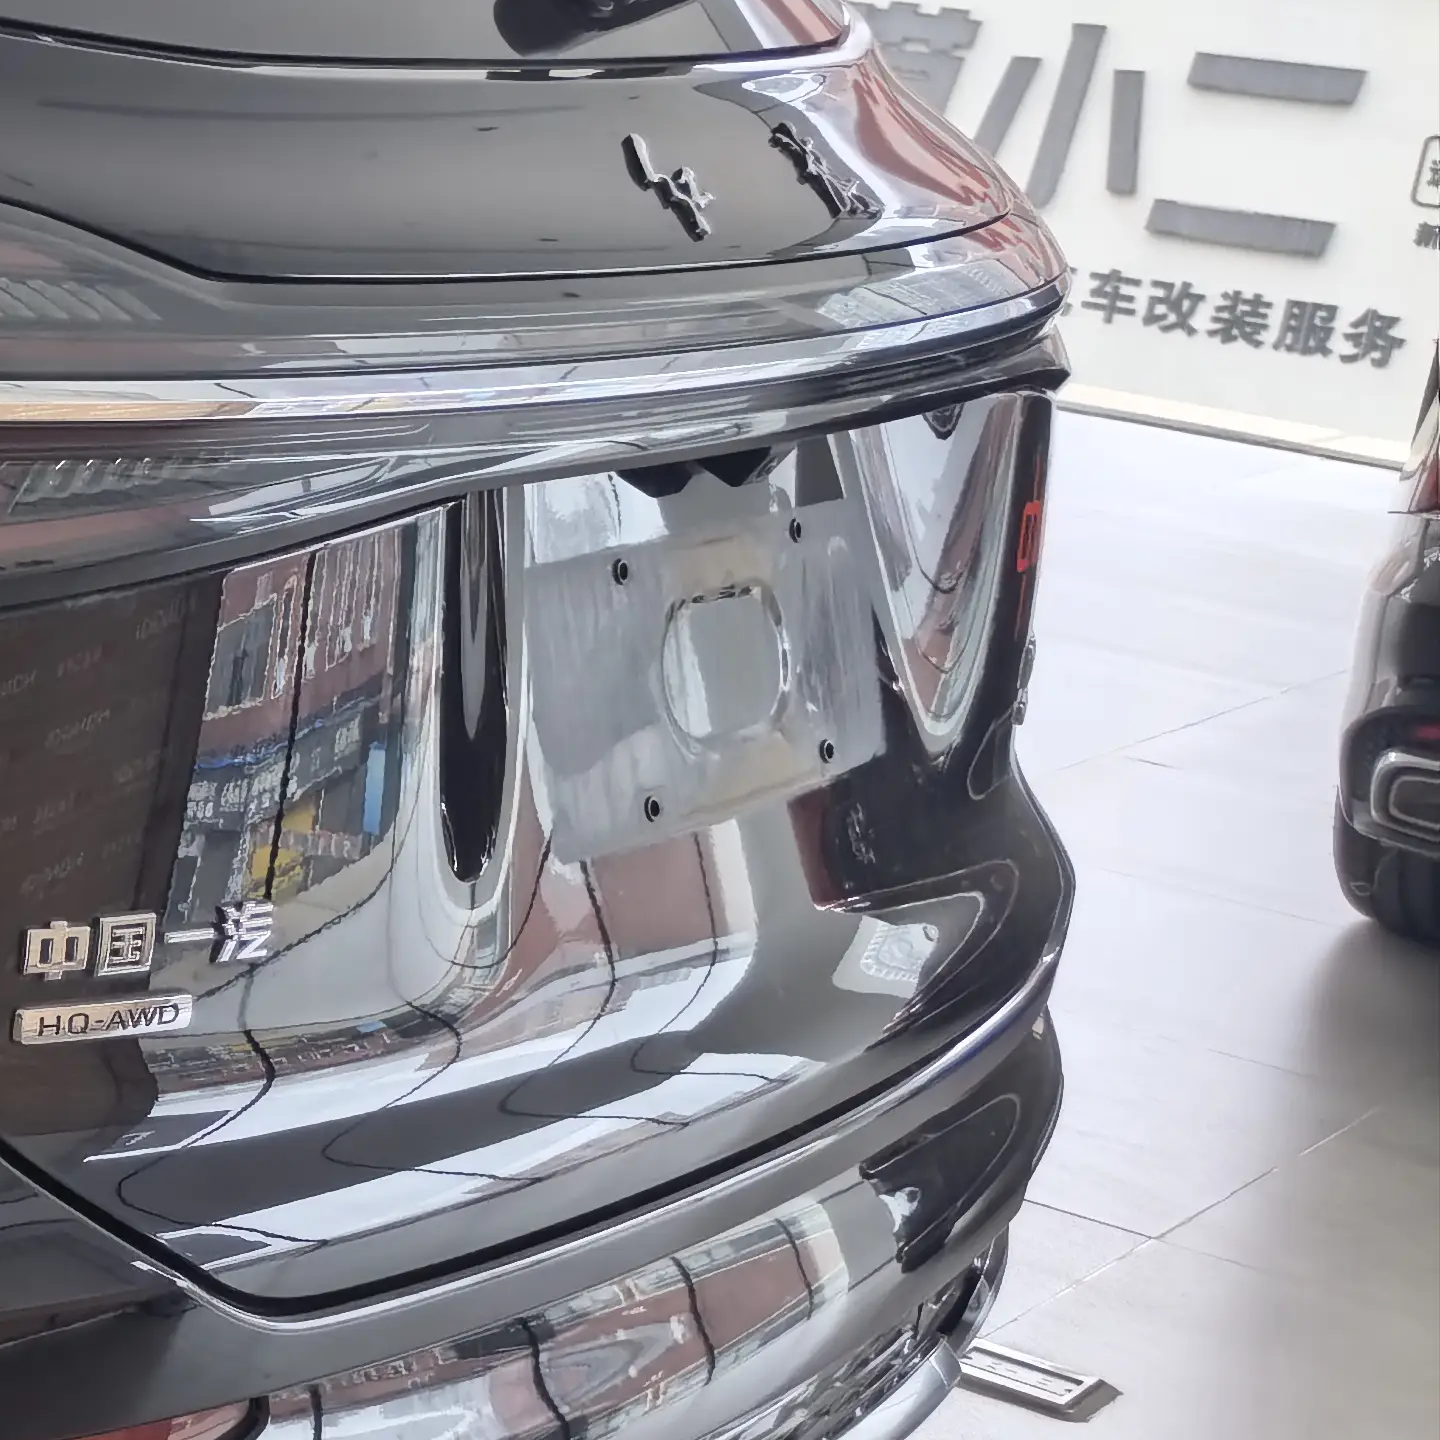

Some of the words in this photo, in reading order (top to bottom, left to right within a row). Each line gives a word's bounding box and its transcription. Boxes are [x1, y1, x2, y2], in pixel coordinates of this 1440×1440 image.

[1063, 266, 1407, 368] 车改装服务
[23, 901, 274, 981] 中国一汽
[37, 1002, 181, 1037] HQ-AWD
